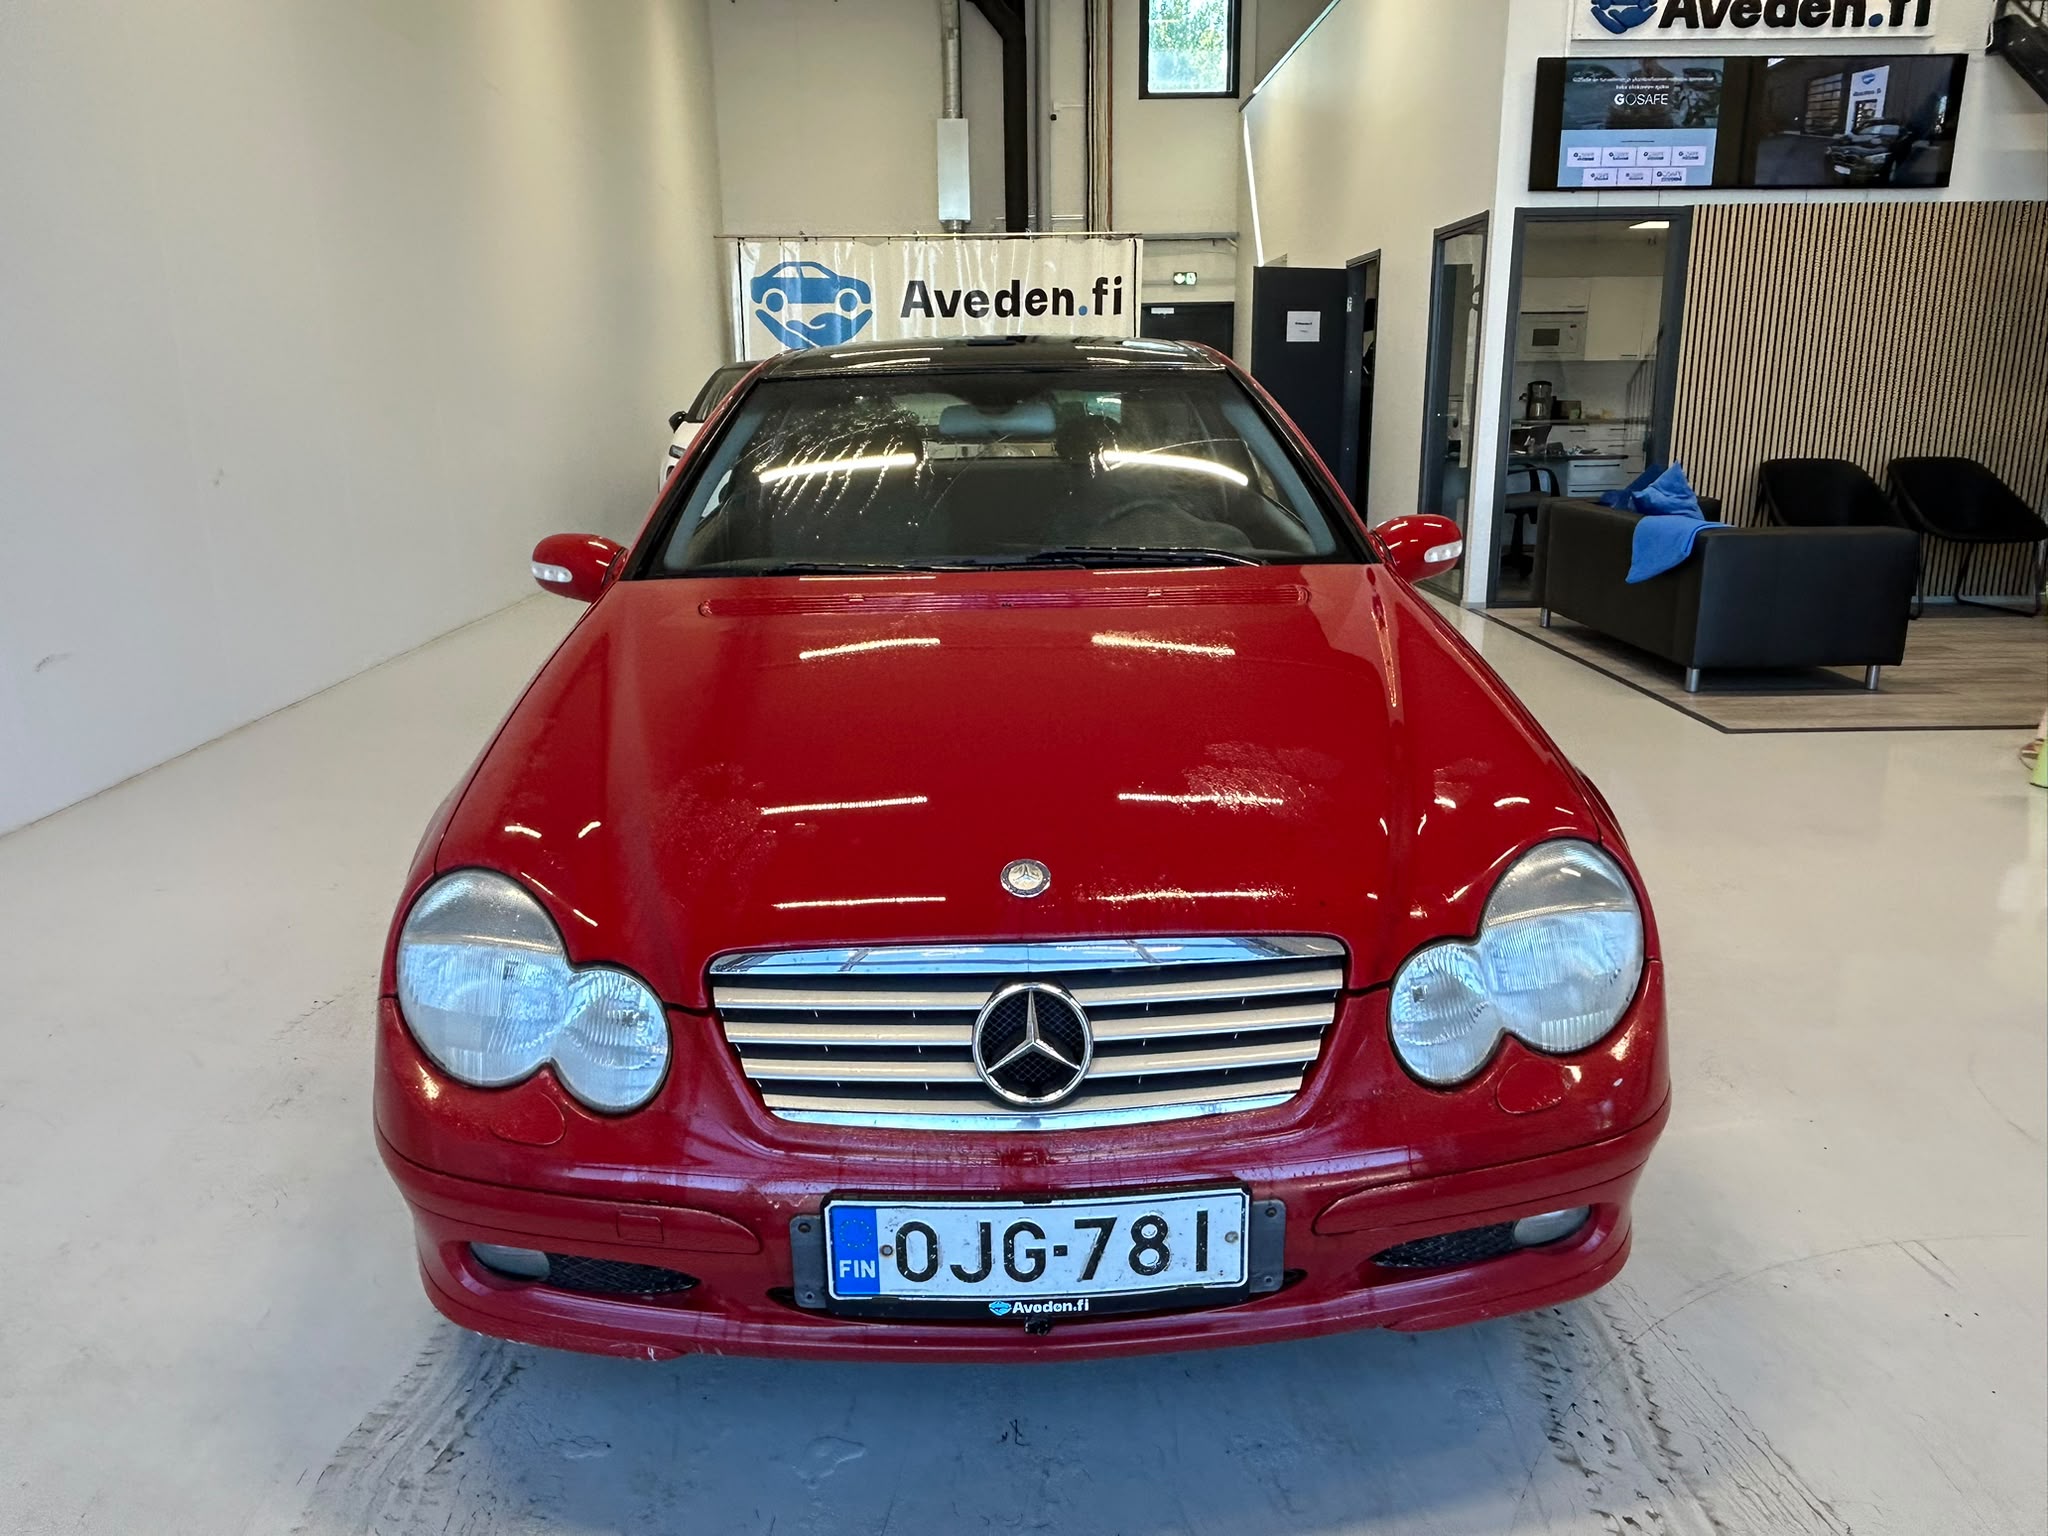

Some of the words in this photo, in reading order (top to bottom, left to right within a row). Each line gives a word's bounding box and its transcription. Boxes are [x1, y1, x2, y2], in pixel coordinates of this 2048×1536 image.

[1614, 93, 1669, 105] GOSAFE
[900, 276, 1122, 318] Aveden.fi
[895, 1210, 1210, 1283] OJG-781
[839, 1259, 876, 1279] FIN
